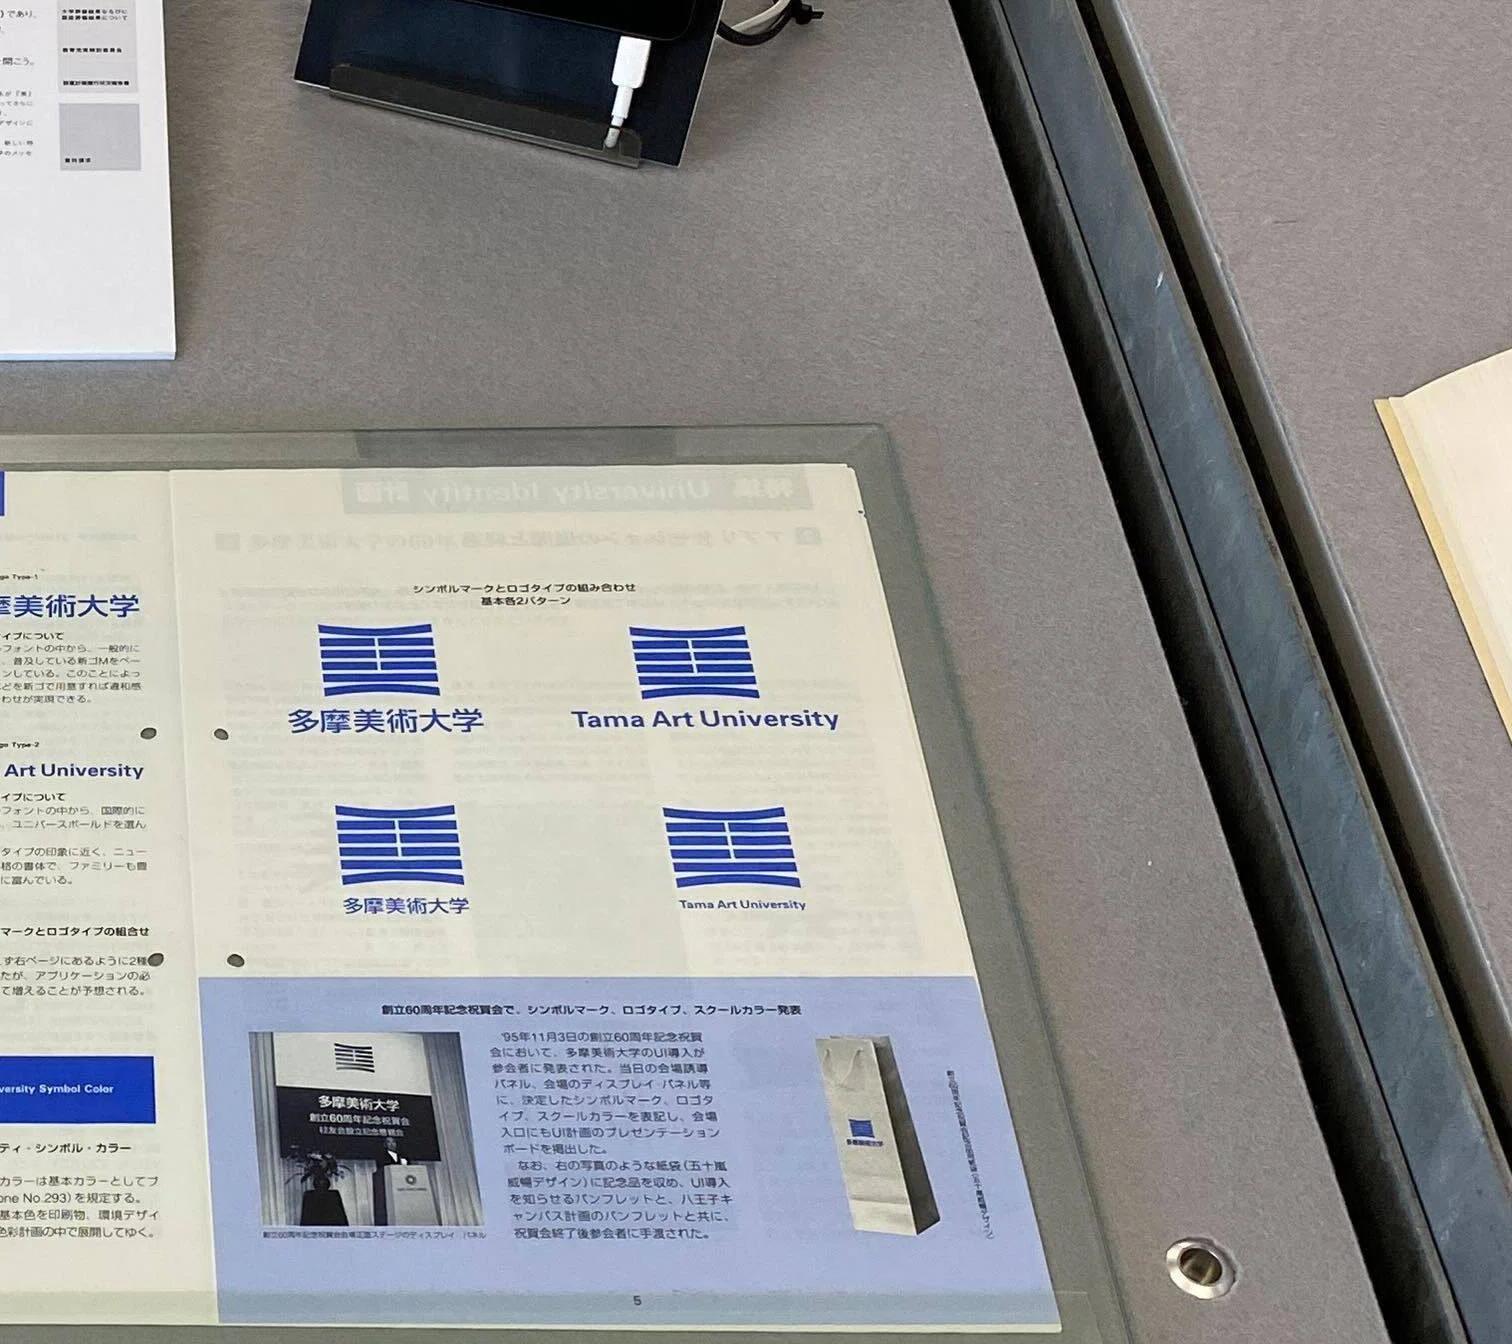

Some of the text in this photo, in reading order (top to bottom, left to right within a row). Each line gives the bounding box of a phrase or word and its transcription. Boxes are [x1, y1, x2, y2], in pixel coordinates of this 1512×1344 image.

[413, 583, 636, 594] シンボルマークとロゴタイプの組み合わせ
[288, 707, 484, 735] 多摩美術大学
[570, 709, 839, 732] Tama Art University
[4, 763, 37, 777] Art
[41, 763, 144, 779] University
[342, 896, 470, 916] 多摩美術大学
[679, 899, 807, 912] Tama Art University
[39, 1084, 80, 1094] Symbol
[84, 1084, 114, 1094] Color
[317, 1094, 400, 1112] 多摩美術大学
[633, 1295, 642, 1306] 5
